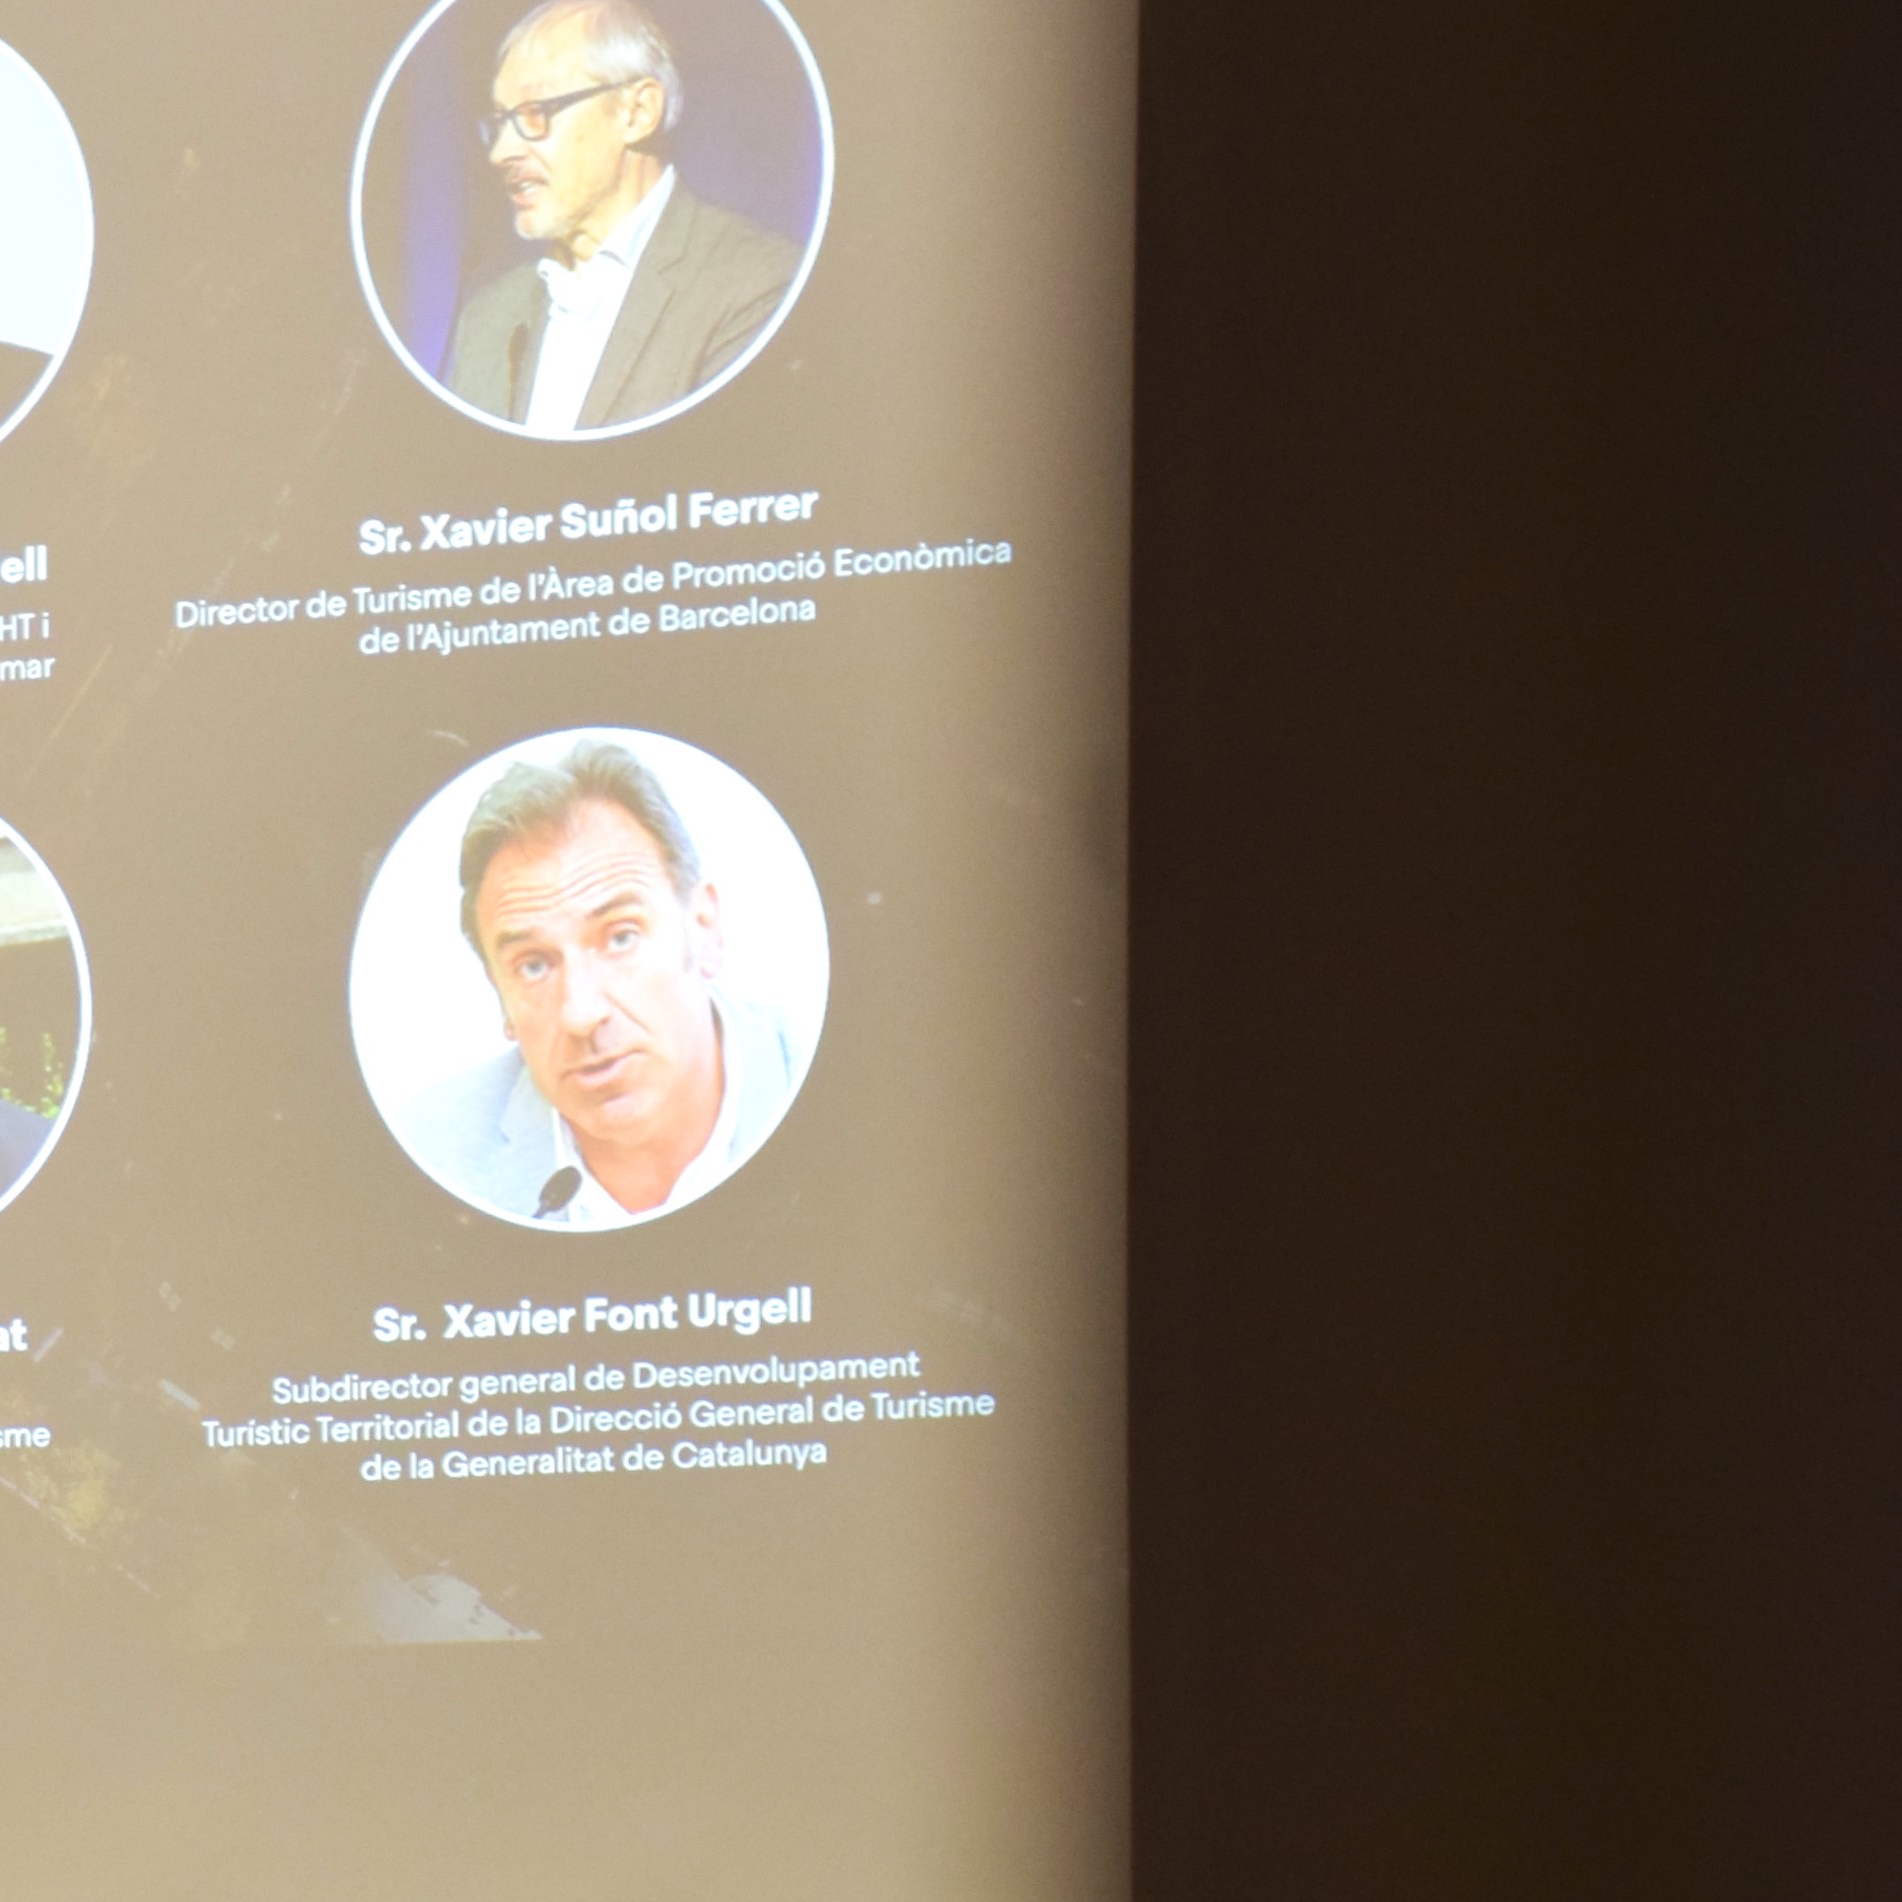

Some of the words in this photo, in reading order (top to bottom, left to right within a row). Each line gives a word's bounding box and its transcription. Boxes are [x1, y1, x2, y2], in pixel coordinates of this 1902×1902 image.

[358, 518, 412, 556] Sr.
[419, 506, 554, 551] Xavier
[559, 492, 678, 540] Suñol
[687, 490, 820, 529] Ferrer
[175, 596, 301, 629] Director
[304, 589, 348, 619] de
[351, 583, 473, 615] Turisme
[478, 575, 522, 606] de
[621, 564, 665, 595] de
[671, 550, 827, 590] Promoció
[832, 537, 1012, 578] Econòmica
[40, 611, 50, 639] i
[358, 625, 401, 655] de
[606, 606, 652, 636] de
[657, 595, 817, 633] Barcelona
[372, 1304, 428, 1343] Sr.
[443, 1298, 577, 1339] Xavier
[583, 1294, 679, 1333] Font
[686, 1284, 812, 1336] Urgell
[272, 1372, 454, 1405] Subdirector
[458, 1363, 577, 1404] general
[583, 1362, 626, 1392] de
[632, 1350, 921, 1392] Desenvolupament
[201, 1416, 311, 1448] Turístic
[314, 1408, 460, 1443] Territorial
[465, 1407, 509, 1437] de
[515, 1406, 542, 1435] la
[549, 1400, 683, 1434] Direcció
[688, 1393, 814, 1428] General
[821, 1392, 866, 1423] de
[869, 1389, 996, 1420] Turisme
[359, 1452, 403, 1482] de
[408, 1451, 435, 1480] la
[441, 1445, 616, 1478] Generalitat
[620, 1442, 665, 1471] de
[670, 1437, 828, 1471] Catalunya
